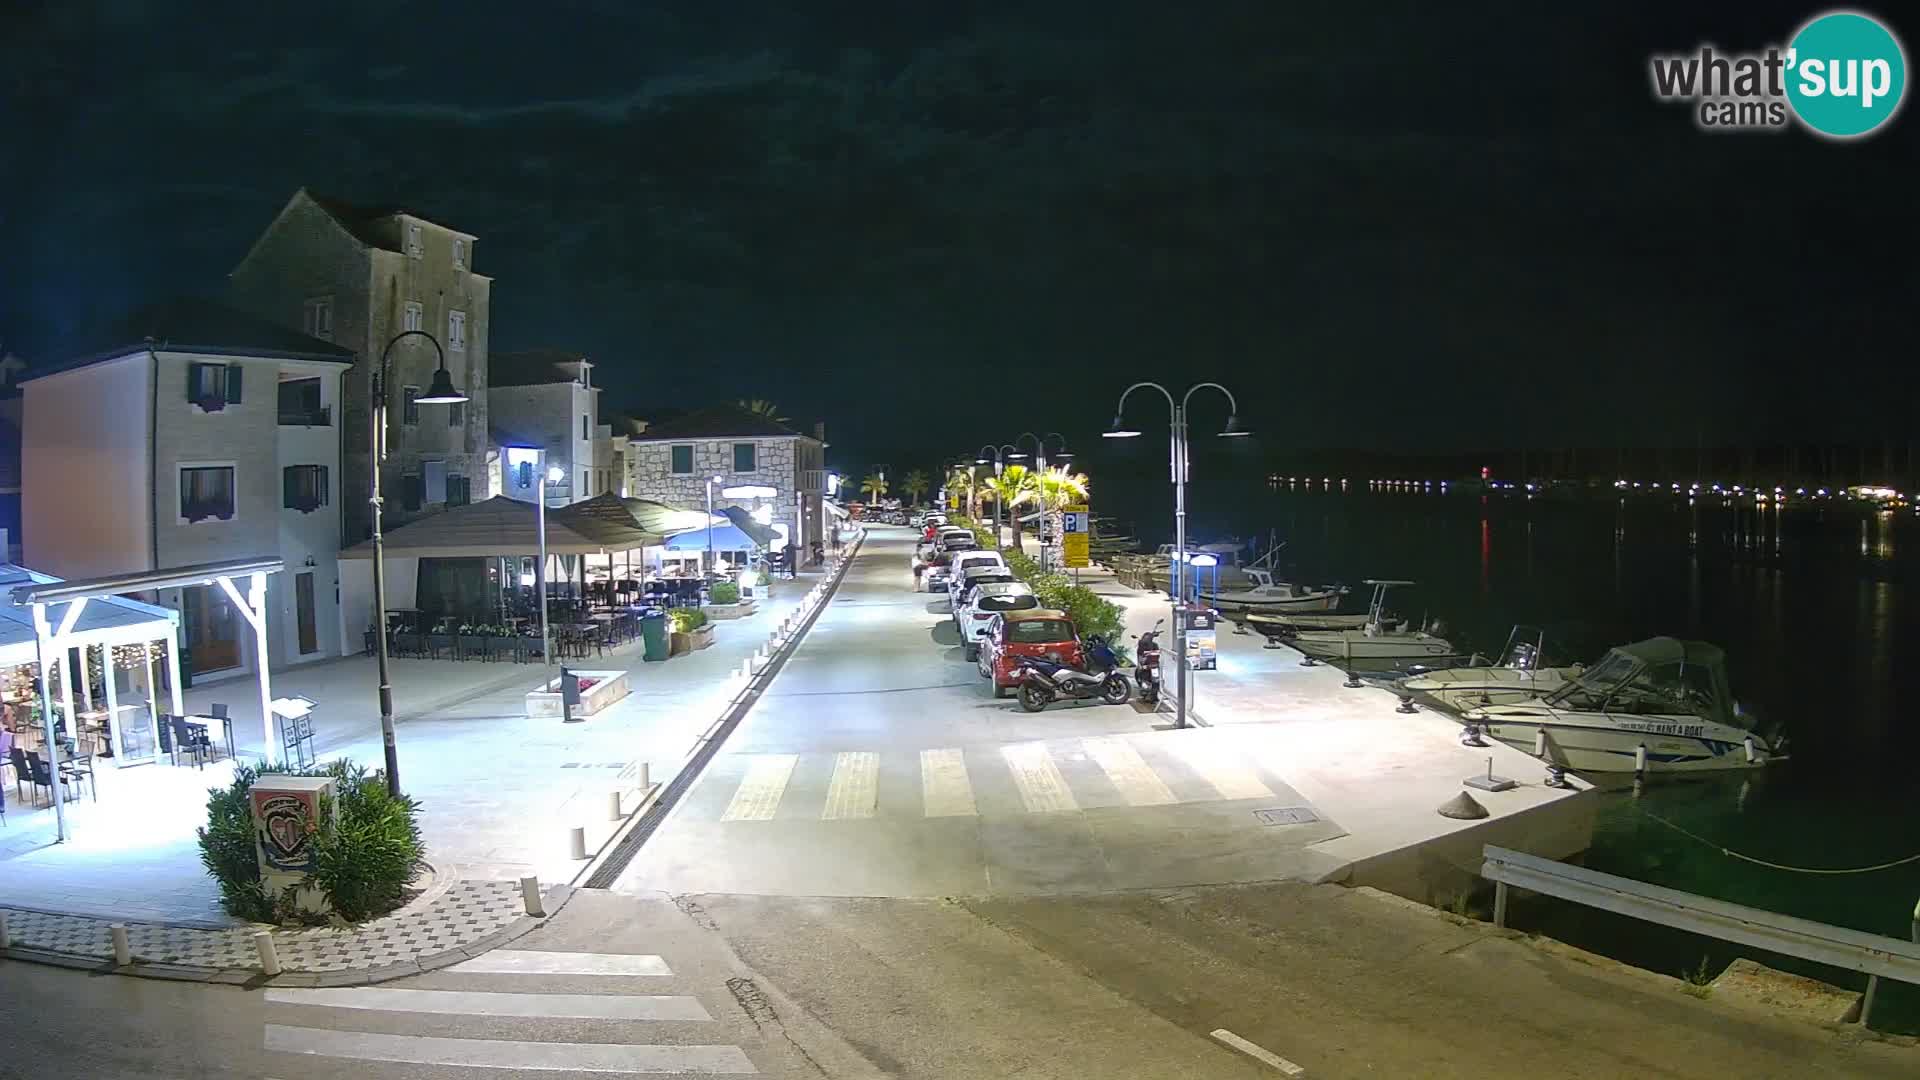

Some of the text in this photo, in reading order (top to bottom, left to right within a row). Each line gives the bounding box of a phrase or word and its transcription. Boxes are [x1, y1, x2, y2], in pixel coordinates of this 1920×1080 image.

[1065, 514, 1076, 531] P
[1656, 724, 1676, 735] RENT
[1678, 725, 1683, 734] A
[1684, 726, 1704, 736] BOAT
